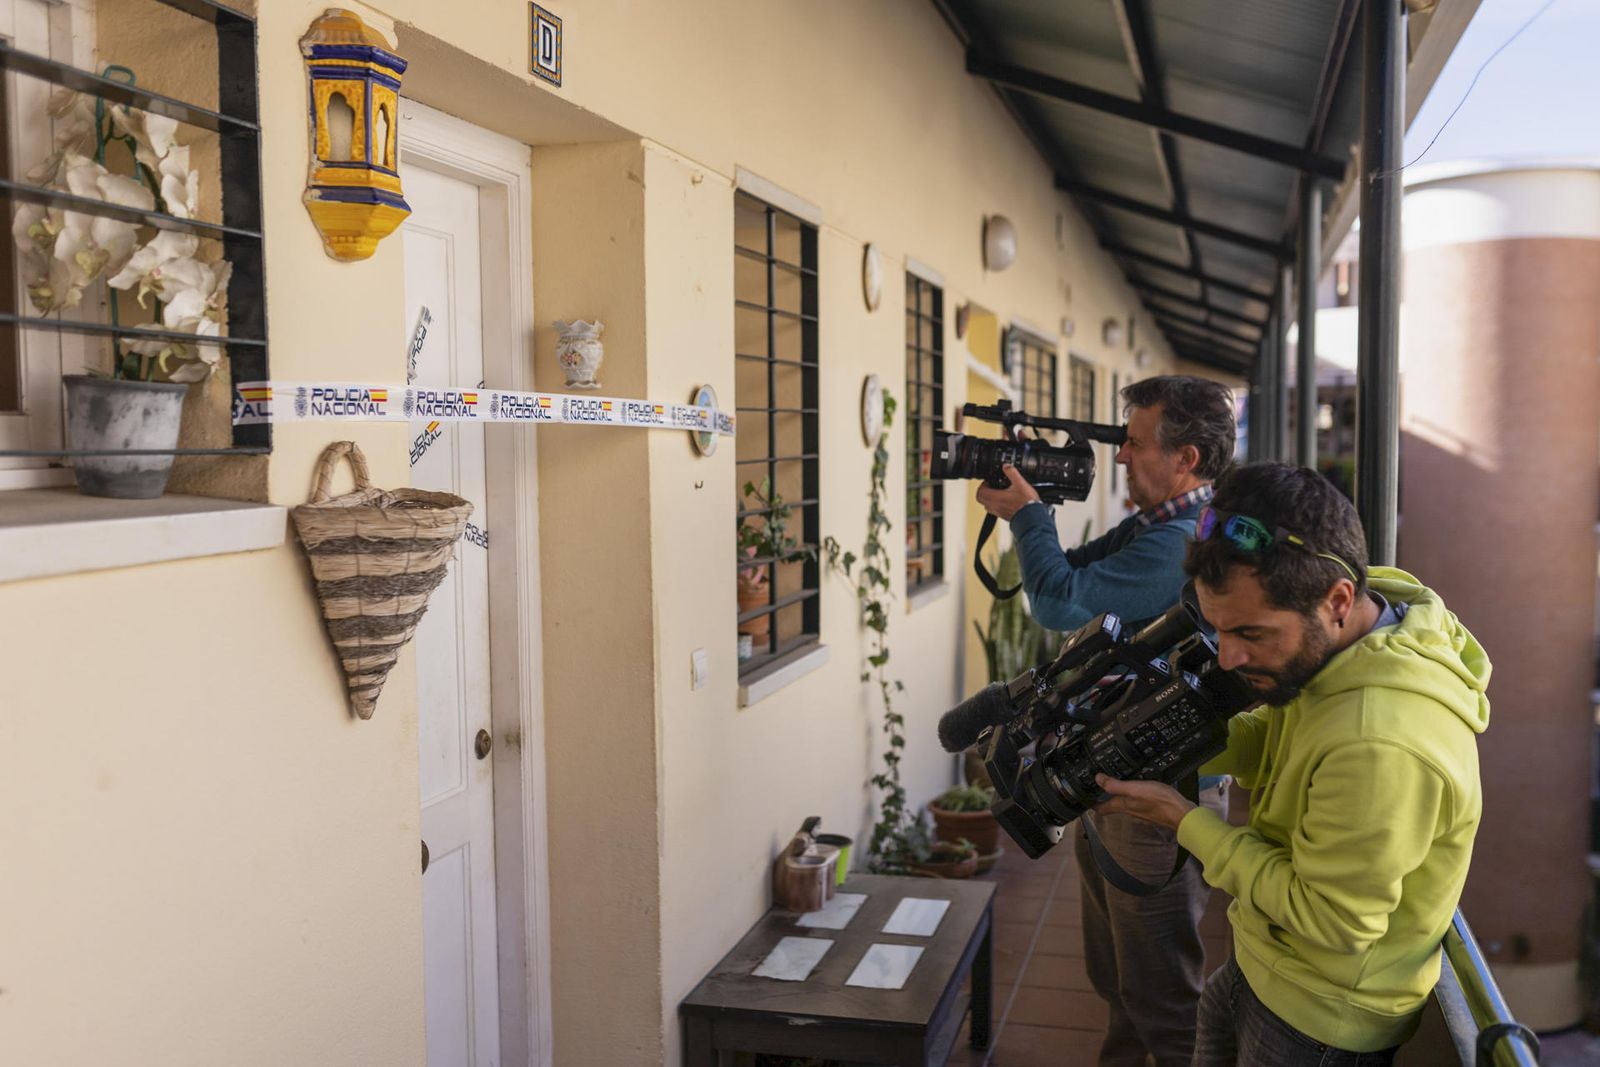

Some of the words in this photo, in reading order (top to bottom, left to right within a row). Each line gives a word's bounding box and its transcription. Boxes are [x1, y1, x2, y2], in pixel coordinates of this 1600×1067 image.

[542, 24, 553, 65] D
[312, 388, 371, 402] POLICIA
[416, 391, 464, 404] POLICIA
[501, 395, 540, 408] POLICIA
[311, 402, 387, 416] NACIONAL
[416, 404, 477, 417] NACIONAL
[570, 399, 603, 411] POLICIA
[627, 403, 656, 414] POLICIA
[501, 407, 552, 419] NACIONAL
[570, 410, 613, 422] NACIONAL
[1155, 682, 1180, 703] SONY
